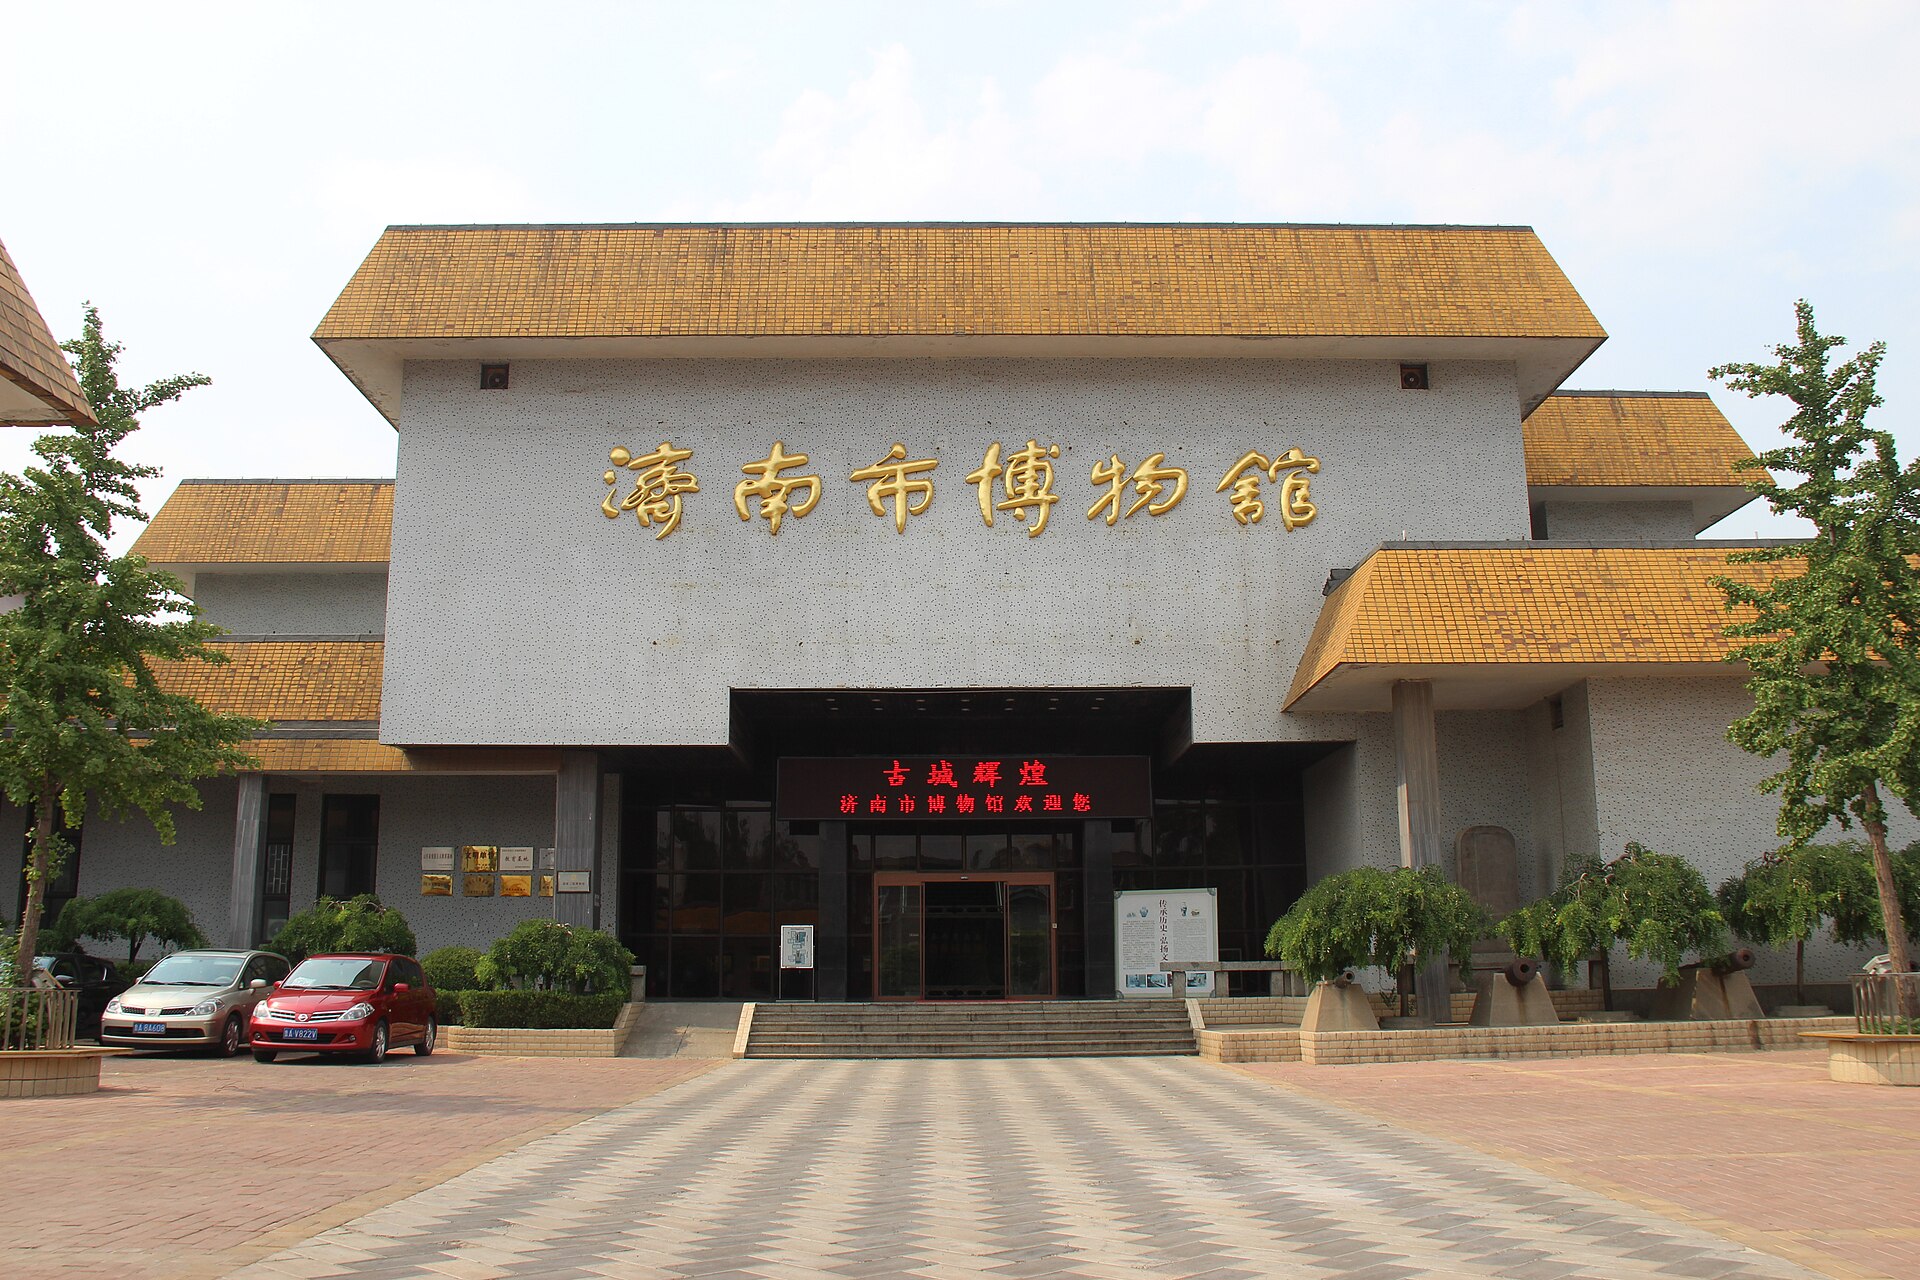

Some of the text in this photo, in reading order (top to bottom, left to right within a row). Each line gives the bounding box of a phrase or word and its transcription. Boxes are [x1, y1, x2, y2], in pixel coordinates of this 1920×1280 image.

[840, 792, 1091, 814] 济南市博物馆欢迎您
